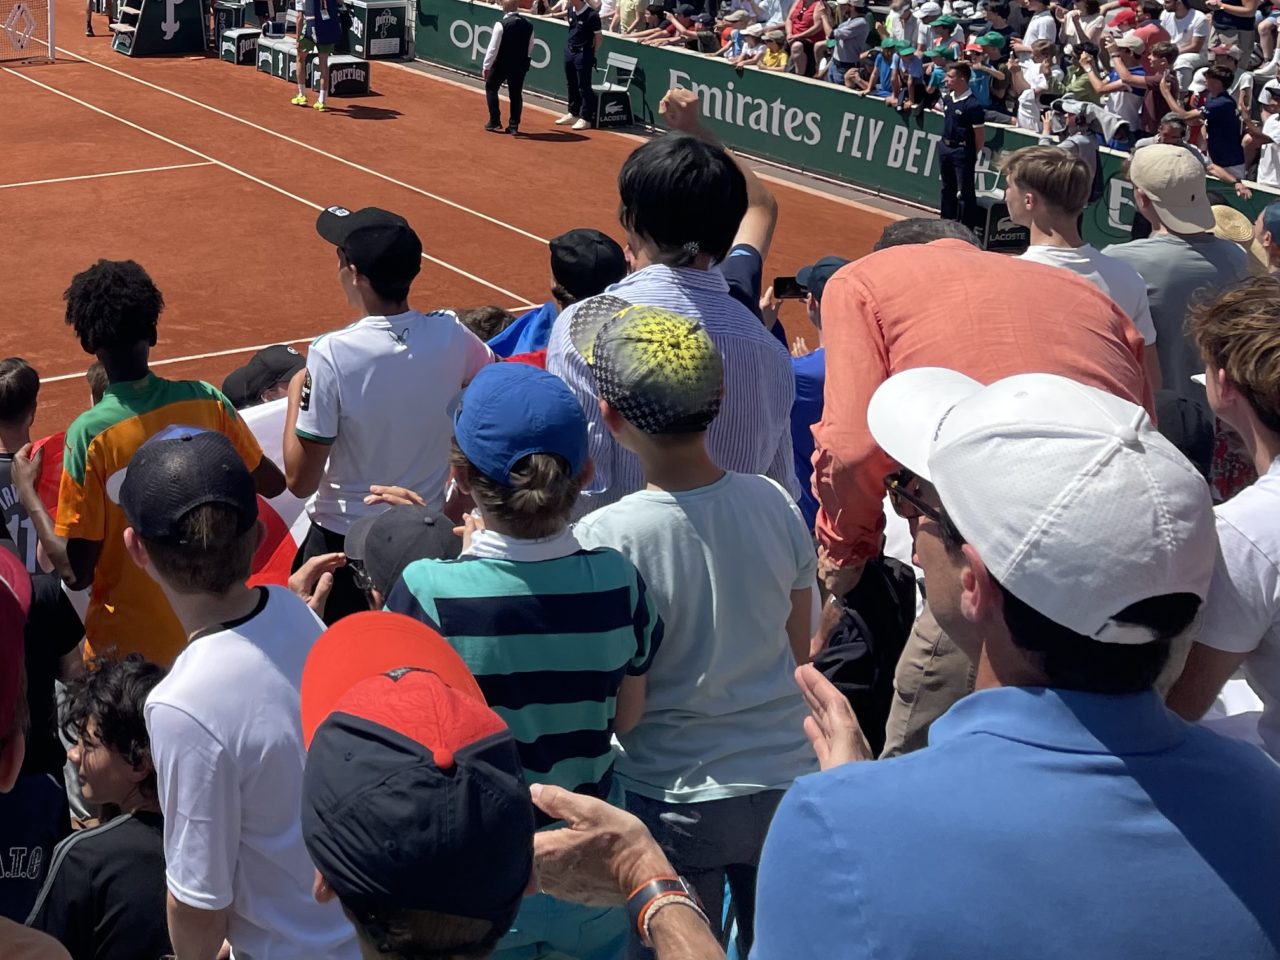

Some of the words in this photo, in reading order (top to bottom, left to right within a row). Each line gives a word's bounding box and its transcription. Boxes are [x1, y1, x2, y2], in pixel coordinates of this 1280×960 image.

[449, 19, 552, 69] opo
[331, 64, 366, 94] perrier
[836, 111, 884, 161] FLY
[989, 232, 1027, 242] LACOSTE
